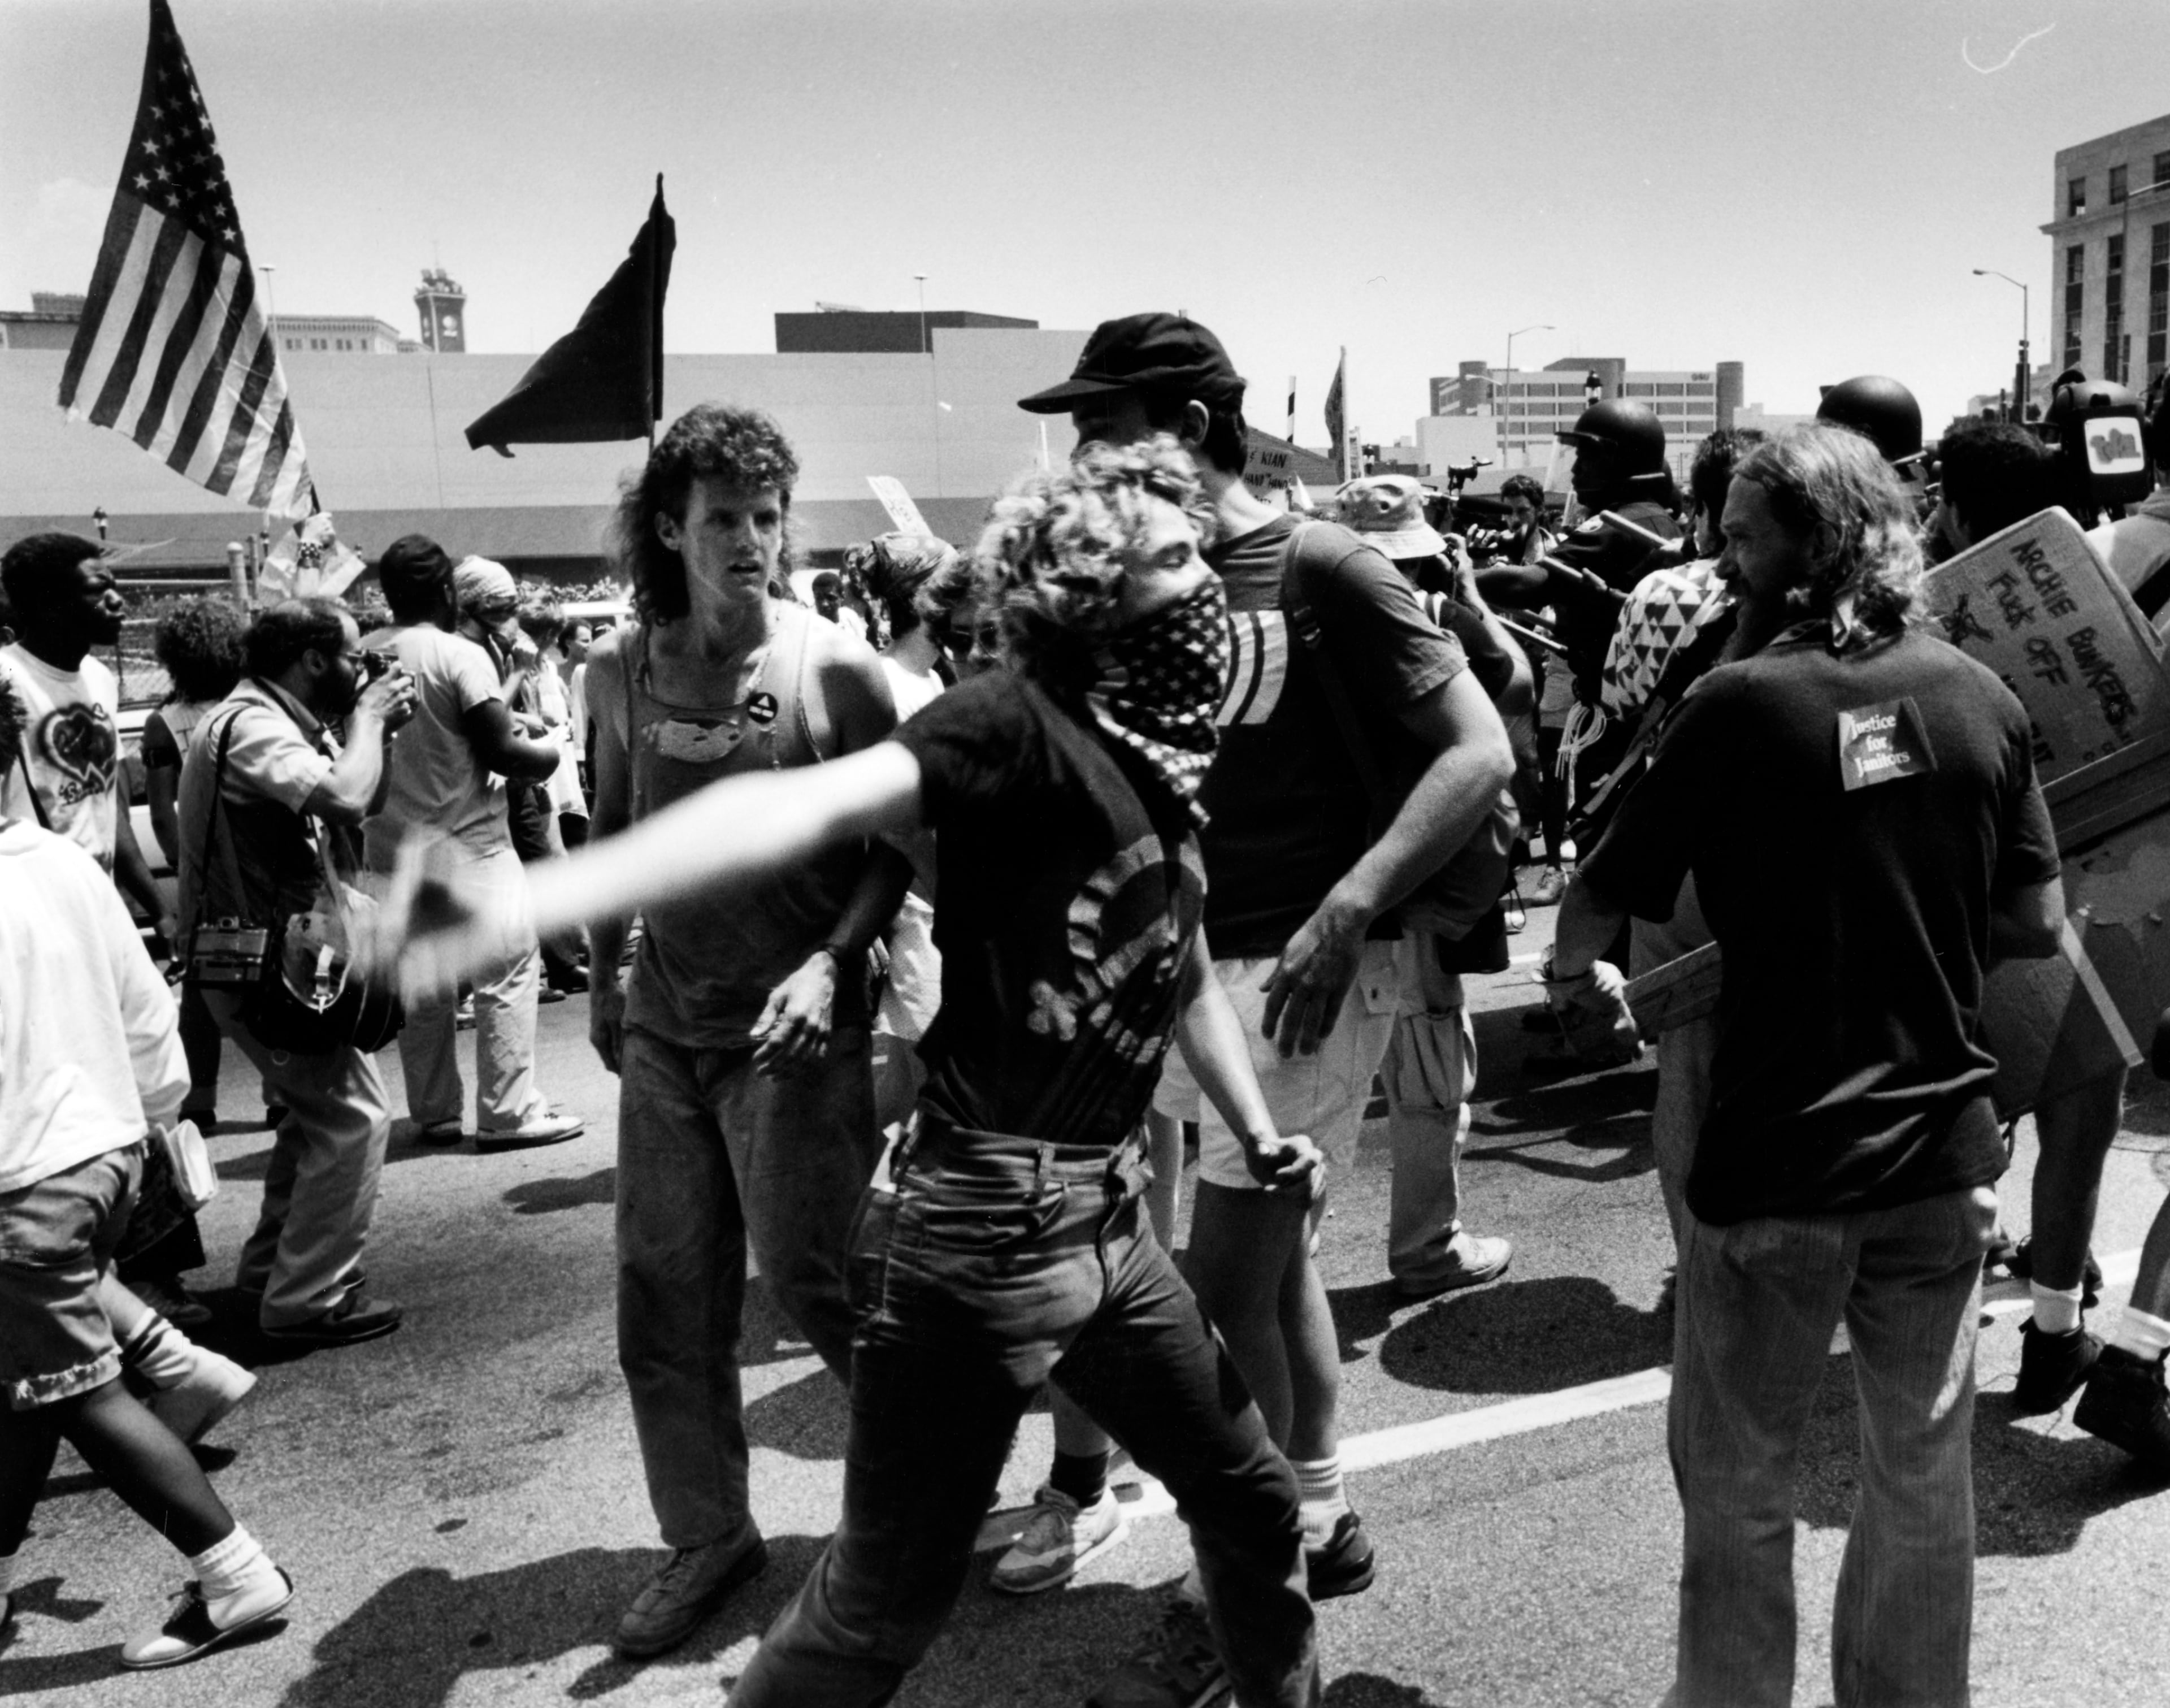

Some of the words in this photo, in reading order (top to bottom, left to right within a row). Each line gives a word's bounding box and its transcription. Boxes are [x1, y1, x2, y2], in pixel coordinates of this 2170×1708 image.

[2010, 539, 2078, 618] ARCHIE
[1850, 714, 1896, 740] Justice
[1866, 735, 1887, 752] for
